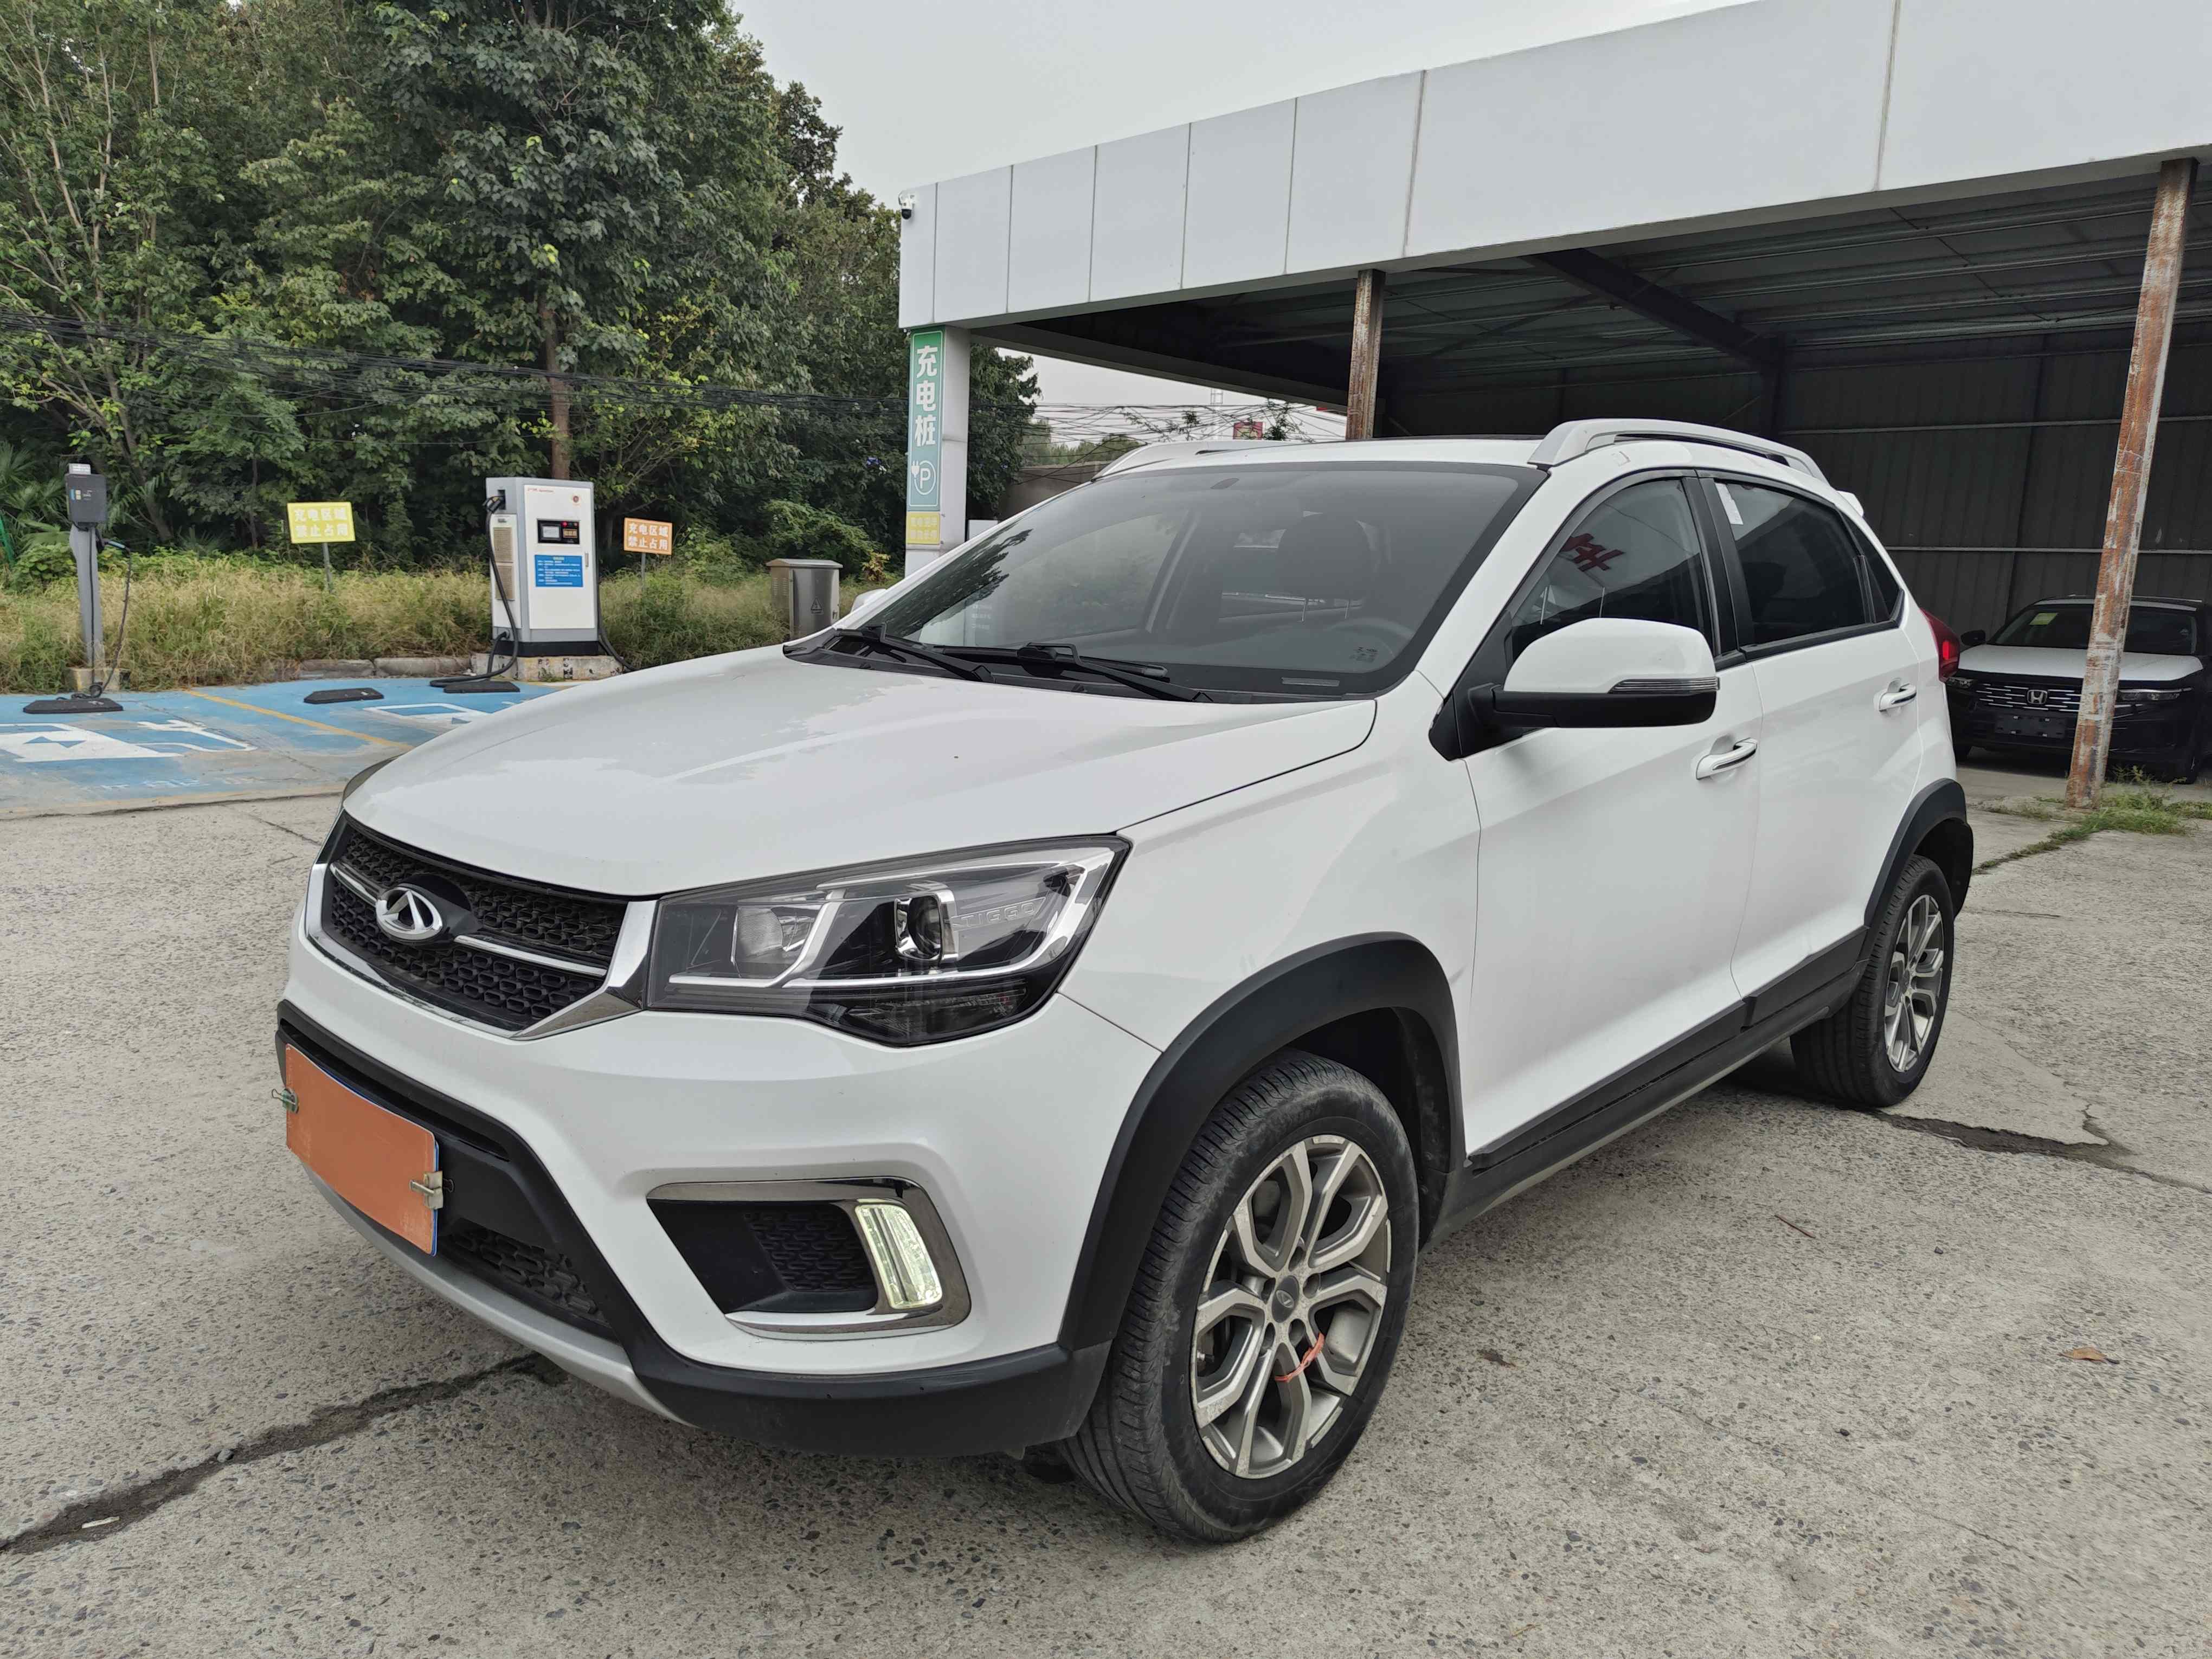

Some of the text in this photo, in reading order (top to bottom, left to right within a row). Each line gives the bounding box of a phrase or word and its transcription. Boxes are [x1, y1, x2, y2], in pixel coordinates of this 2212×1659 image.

[915, 345, 938, 447] 充电桩
[628, 523, 668, 537] 充电区域
[628, 536, 668, 550] 禁止占用
[961, 902, 1035, 928] TIGGO
